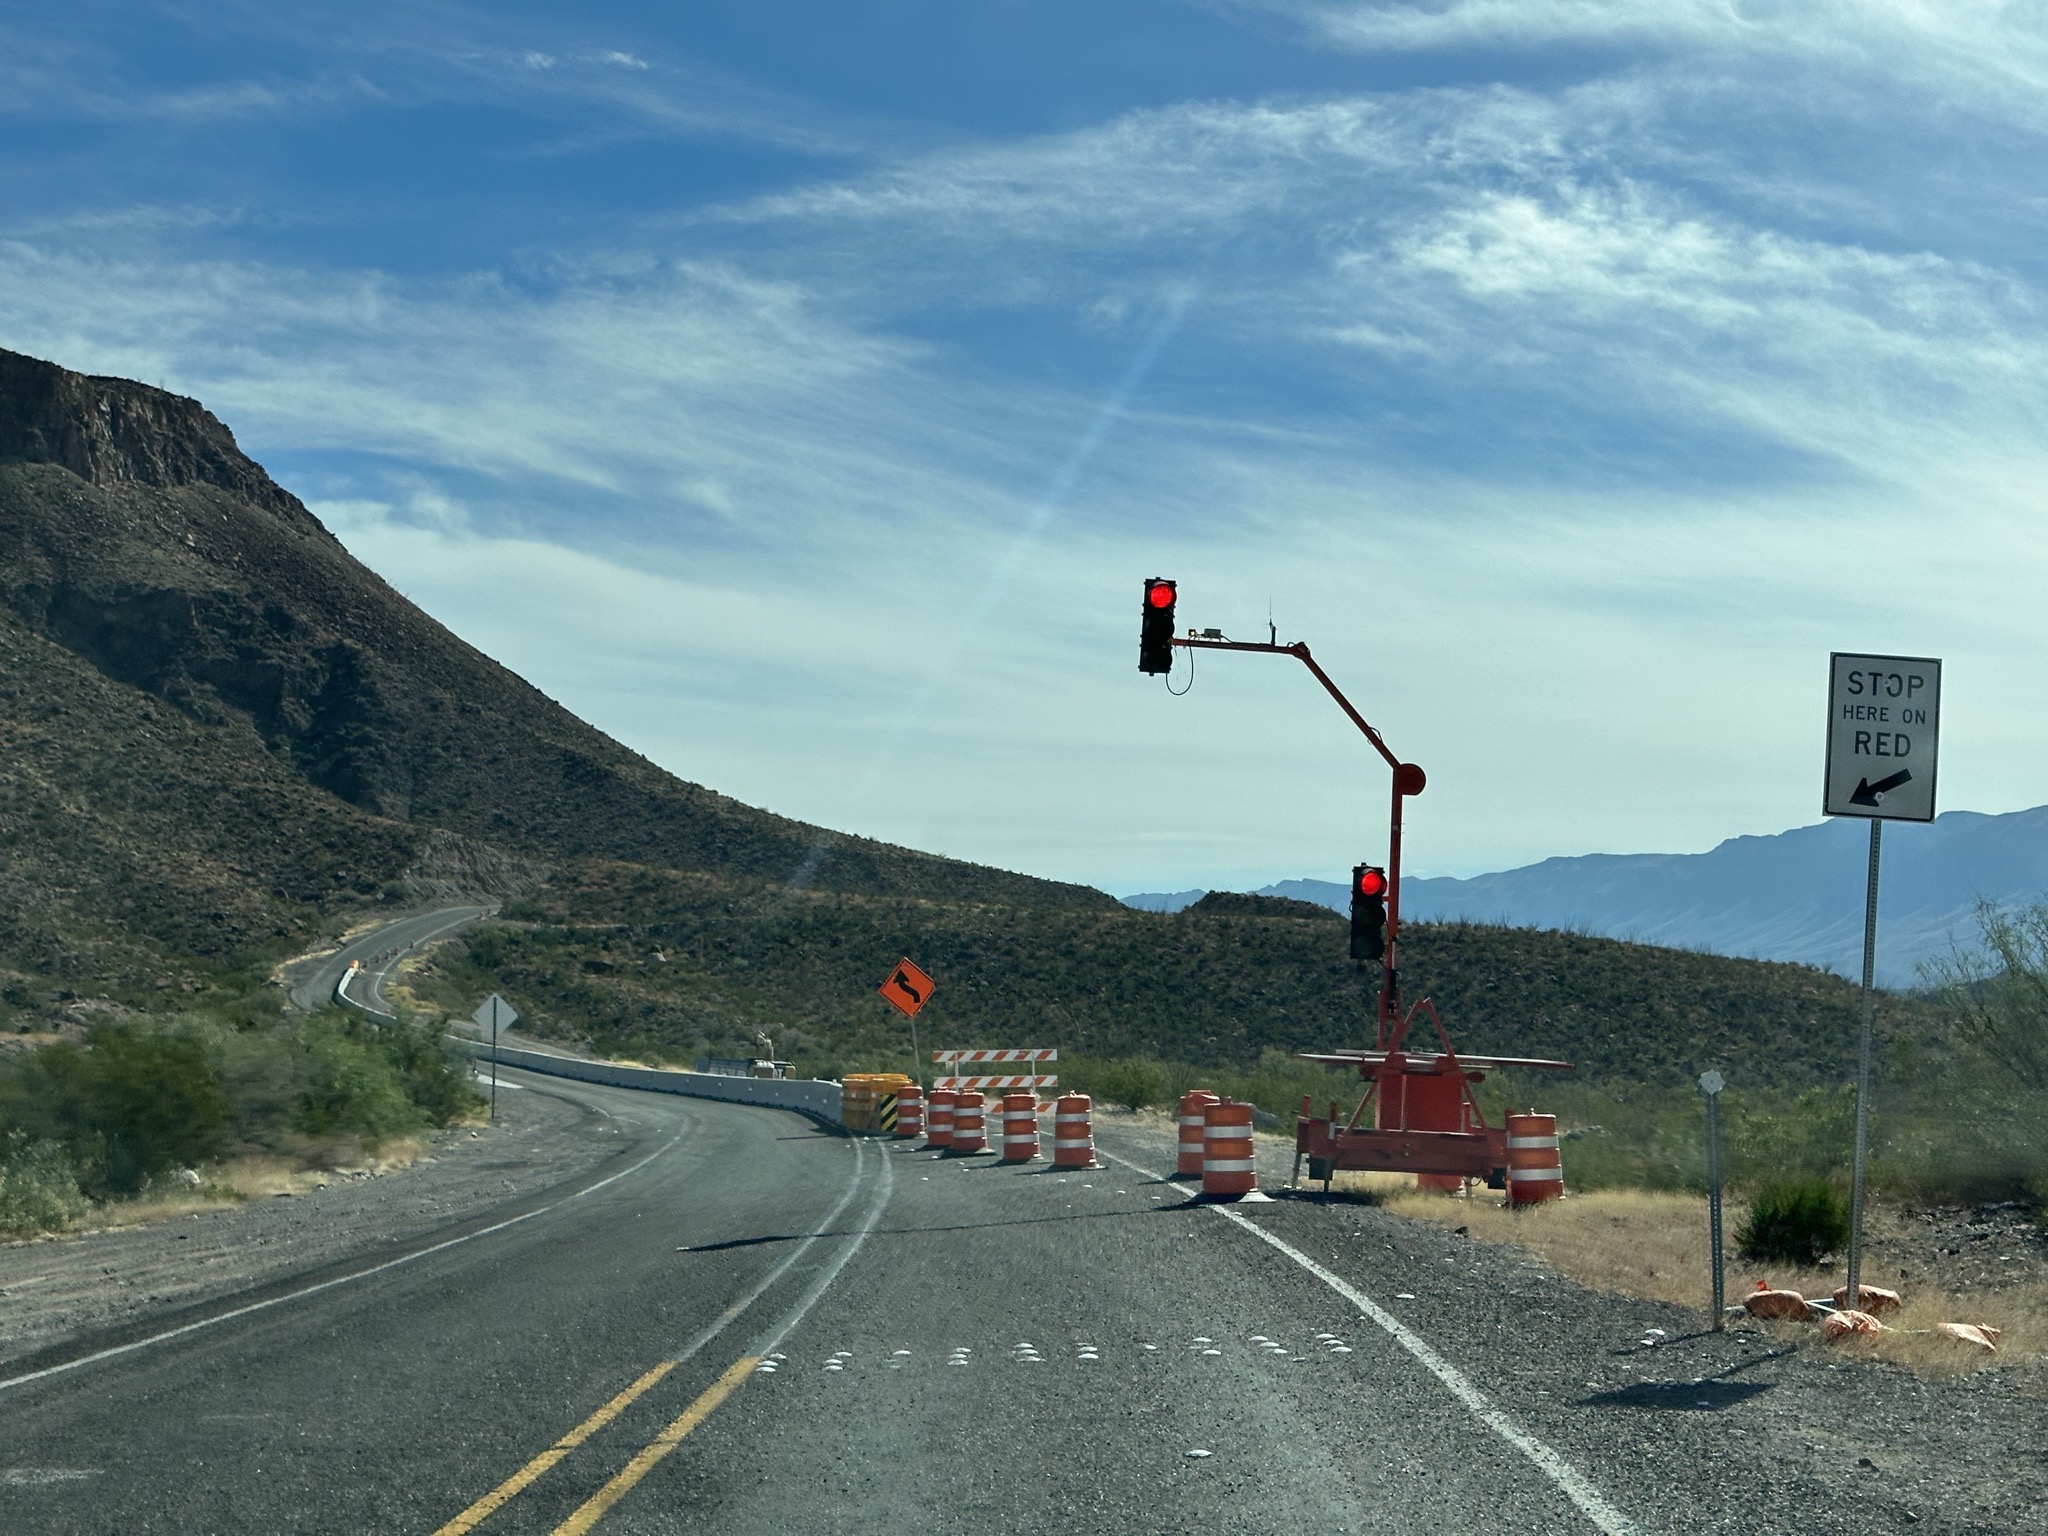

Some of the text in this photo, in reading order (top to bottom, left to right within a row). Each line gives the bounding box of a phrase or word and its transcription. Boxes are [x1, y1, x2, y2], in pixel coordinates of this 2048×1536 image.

[1847, 670, 1924, 698] STOP
[1843, 704, 1926, 725] HERE ON
[1854, 730, 1912, 758] RED
